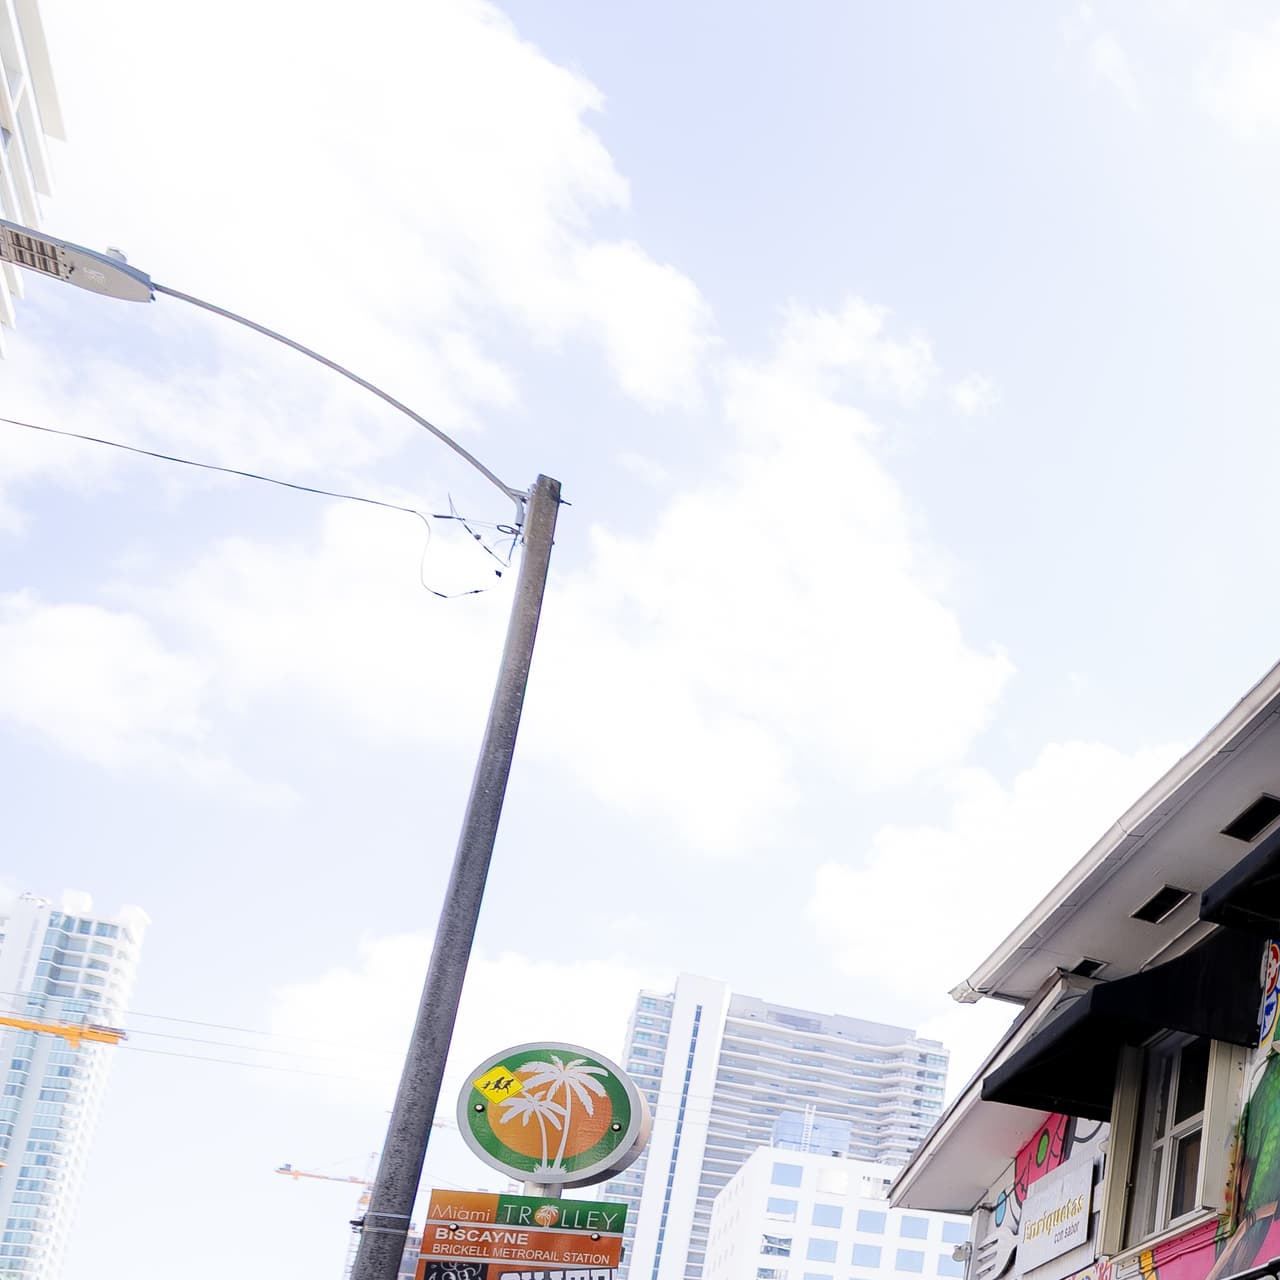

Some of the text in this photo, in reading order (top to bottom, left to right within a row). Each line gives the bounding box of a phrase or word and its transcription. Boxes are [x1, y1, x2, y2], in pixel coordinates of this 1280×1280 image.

[431, 1203, 491, 1222] Miami
[435, 1228, 528, 1245] BISCAYNE
[432, 1244, 610, 1264] BRICKELL METRORAIL STATION
